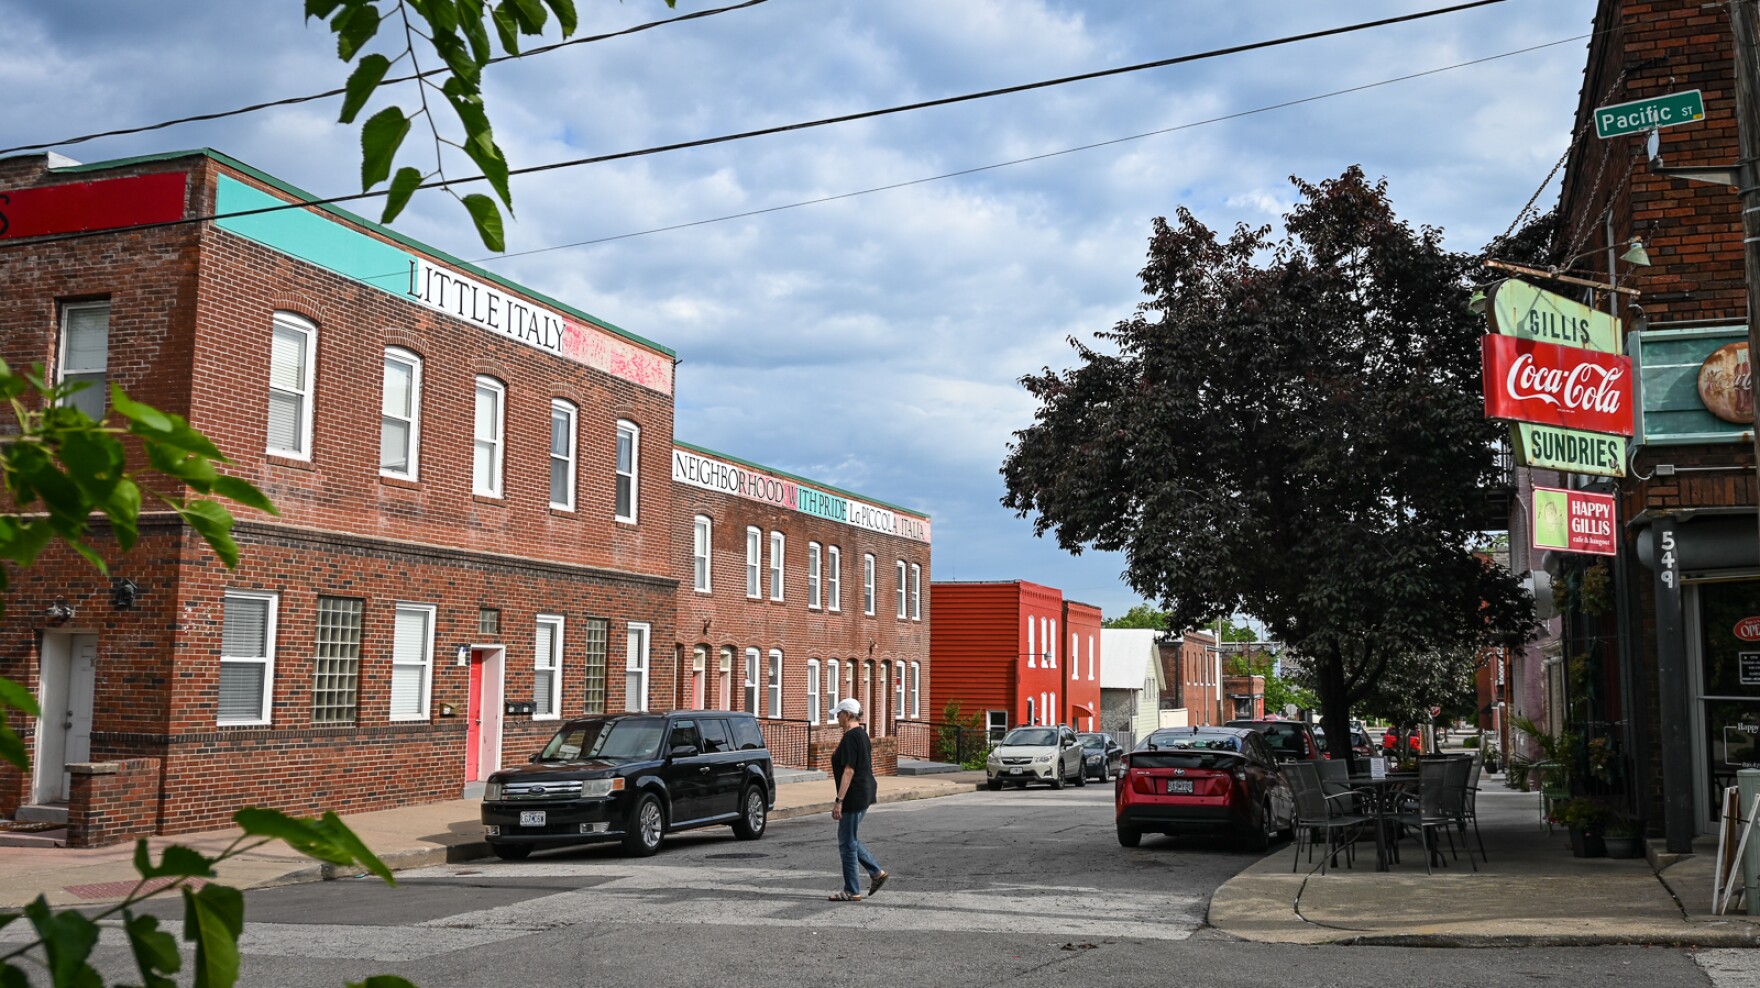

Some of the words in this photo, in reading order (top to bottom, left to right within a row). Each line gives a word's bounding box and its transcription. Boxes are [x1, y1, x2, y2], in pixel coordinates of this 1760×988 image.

[1602, 105, 1672, 131] Pacific
[1681, 106, 1693, 117] ST
[407, 259, 500, 329] LITTLE
[506, 300, 566, 350] ITALY
[1530, 309, 1590, 344] GILLIS
[1507, 353, 1624, 414] Coca-Cola
[1531, 430, 1618, 469] SUNDRIES
[675, 453, 784, 503] NEIGHBORHOOD
[787, 485, 818, 513] WITH
[819, 494, 847, 521] PRIDE
[861, 506, 898, 533] PICCOLA
[901, 518, 925, 541] ITALIA
[1572, 500, 1610, 519] HAPPY
[1571, 517, 1611, 536] GILLIS
[1661, 531, 1676, 589] 549
